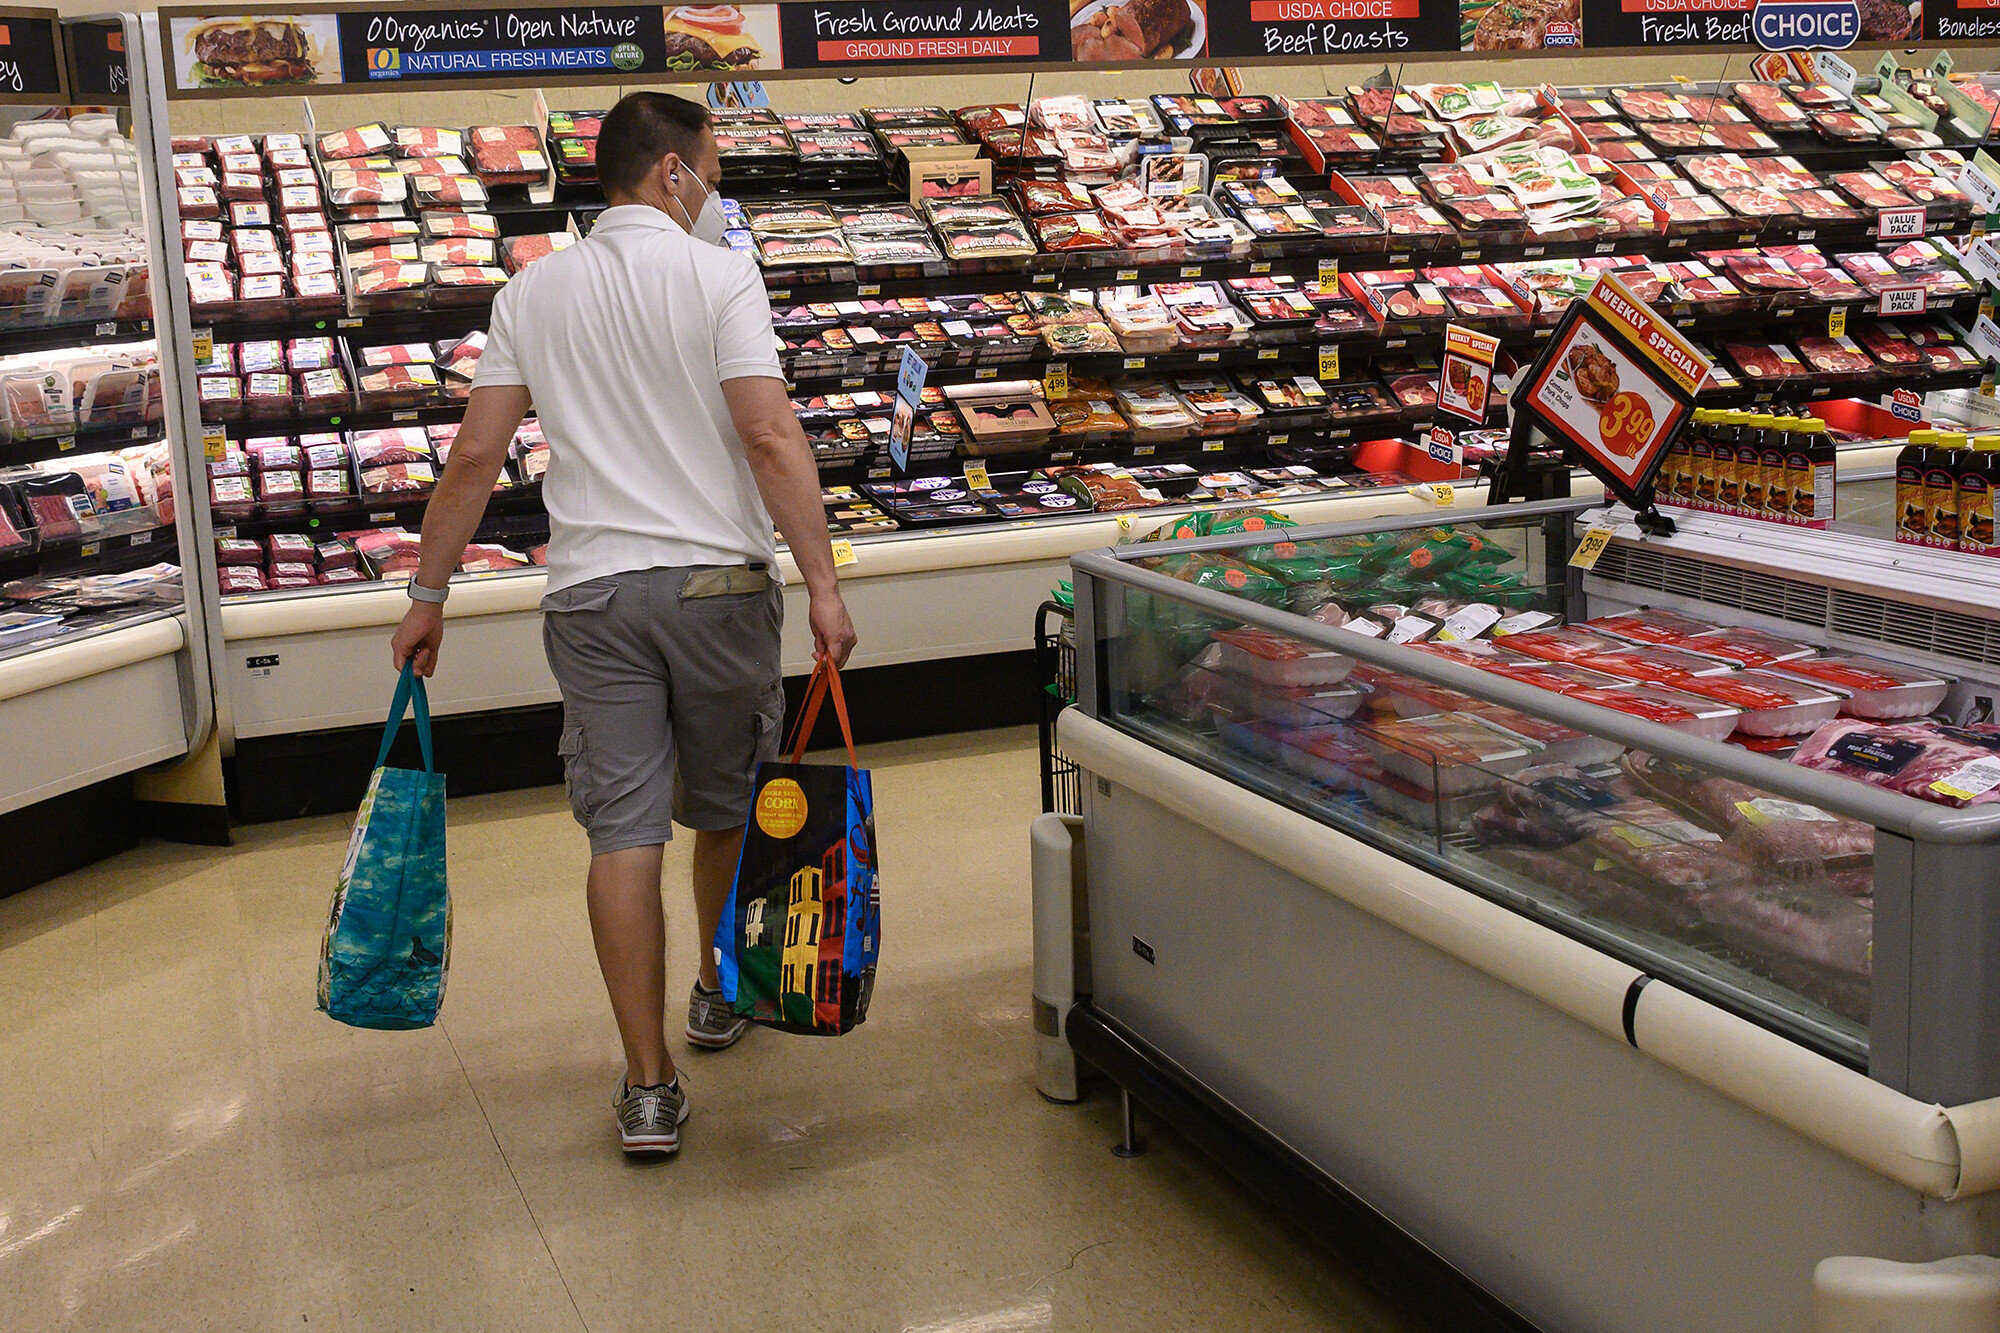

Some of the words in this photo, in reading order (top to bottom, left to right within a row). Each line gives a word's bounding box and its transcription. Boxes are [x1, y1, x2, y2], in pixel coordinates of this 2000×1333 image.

[1278, 2, 1324, 18] USDA
[1329, 0, 1392, 17] CHOICE
[814, 8, 876, 35] Fresh
[882, 6, 962, 35] Ground
[969, 5, 1039, 31] Meats
[1641, 13, 1700, 42] Fresh
[1705, 13, 1750, 42] Beef
[1760, 12, 1853, 38] CHOICE
[506, 13, 555, 46] Open
[561, 10, 637, 37] Nature
[1550, 25, 1570, 35] USDA
[1264, 26, 1317, 55] Beef
[1322, 21, 1409, 51] Roasts
[1546, 35, 1573, 46] CHOICE
[614, 51, 640, 59] NATURE
[846, 43, 914, 58] GROUND
[918, 41, 967, 56] FRESH
[972, 40, 1013, 55] DAILY
[408, 52, 486, 71] NATURAL
[491, 51, 546, 67] FRESH
[551, 49, 607, 65] MEATS
[1888, 215, 1916, 224] VALUE
[1890, 225, 1914, 234] PACK
[1889, 292, 1917, 301] VALUE
[1598, 284, 1649, 330] WEEKLY
[1891, 301, 1914, 311] PACK
[1449, 332, 1470, 344] WEEKLY
[1471, 339, 1493, 352] SPECIAL
[1648, 331, 1698, 379] SPECIAL
[1657, 356, 1681, 379] member
[1678, 375, 1693, 391] price
[1897, 393, 1916, 405] USDA
[1893, 405, 1919, 420] CHOICE
[1434, 431, 1450, 445] USDA
[1430, 445, 1451, 460] CHOICE
[764, 796, 798, 810] CORN
